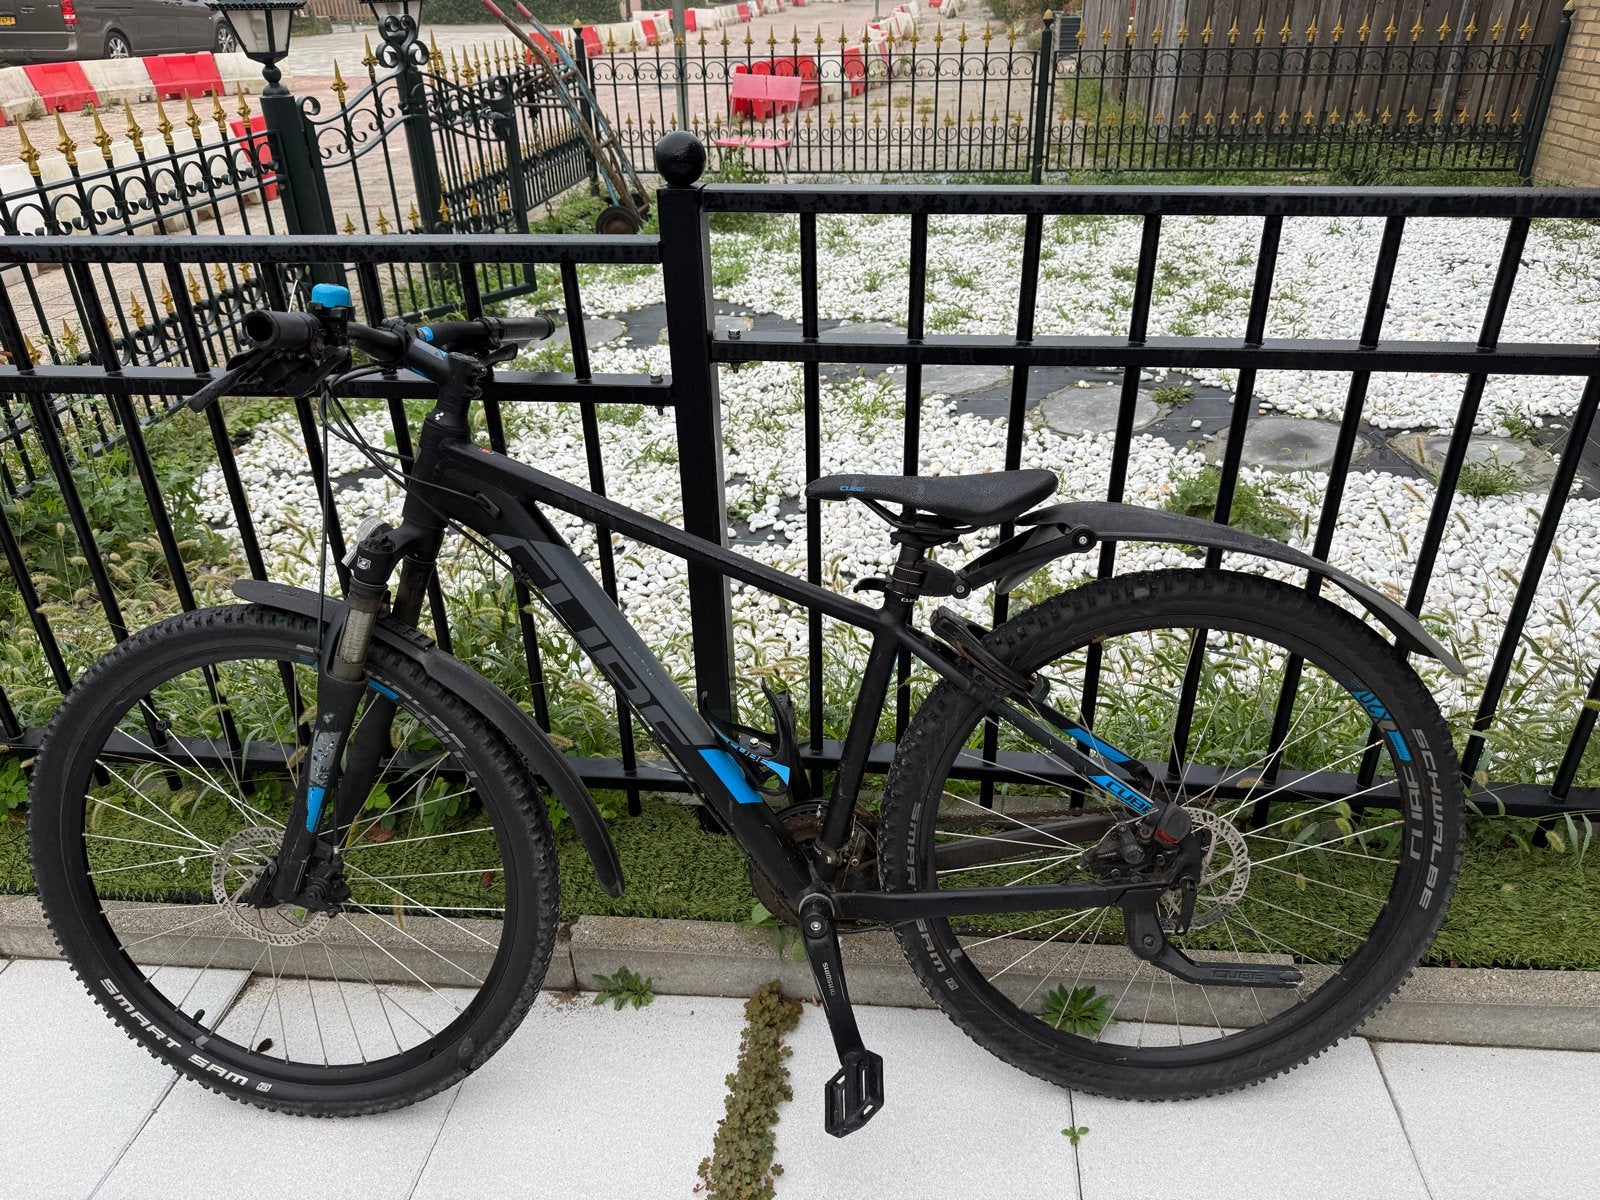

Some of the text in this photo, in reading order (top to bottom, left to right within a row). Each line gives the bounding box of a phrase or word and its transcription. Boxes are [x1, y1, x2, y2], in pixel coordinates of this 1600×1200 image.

[906, 801, 921, 891] SMAR
[1411, 728, 1444, 910] SCHWALBE
[915, 918, 946, 973] SAM
[1213, 969, 1265, 979] CUBE
[100, 978, 249, 1086] SMART SAM
